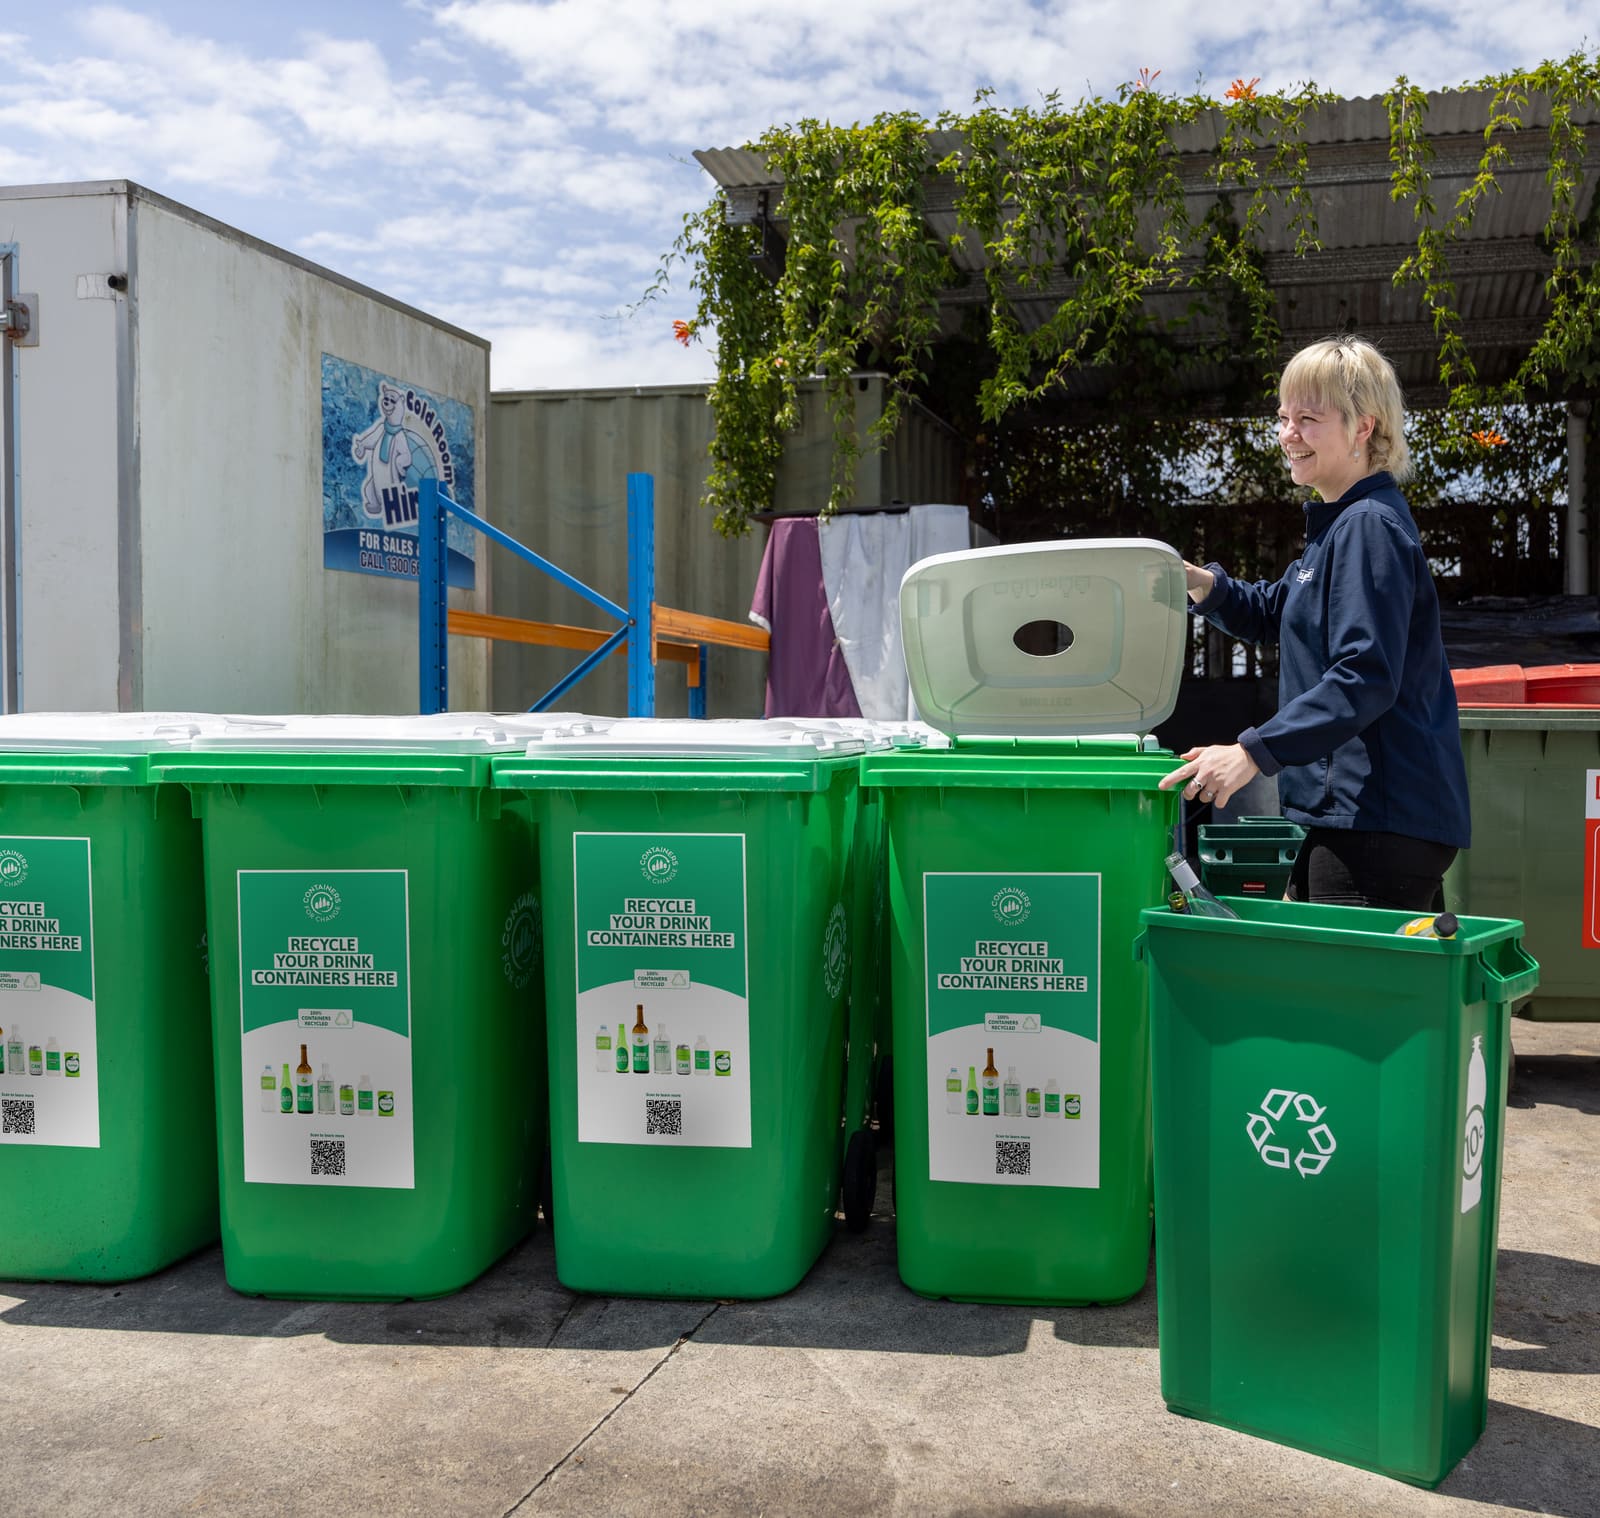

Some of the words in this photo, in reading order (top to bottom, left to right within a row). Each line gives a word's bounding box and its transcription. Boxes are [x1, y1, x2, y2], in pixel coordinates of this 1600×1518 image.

[406, 390, 434, 427] Cold
[432, 422, 454, 486] Room
[360, 531, 380, 550] FOR
[383, 536, 413, 556] SALES
[360, 550, 384, 570] CALL
[386, 555, 409, 575] 1300
[640, 846, 679, 866] CONTAINERS
[4, 872, 28, 887] CHANGE
[641, 868, 652, 881] FOR
[652, 868, 678, 884] CHANGE
[303, 884, 342, 904] CONTAINERS
[992, 888, 1032, 908] CONTAINERS
[304, 905, 316, 919] FOR
[316, 906, 341, 922] CHANGE
[628, 900, 692, 913] RECYCLE
[612, 916, 656, 929] YOUR
[660, 916, 708, 930] DRINK
[992, 908, 1004, 922] FOR
[1004, 910, 1031, 926] CHANGE
[12, 920, 58, 932] DRINK
[42, 936, 79, 950] HERE
[291, 938, 356, 952] RECYCLE
[590, 932, 686, 946] CONTAINERS
[692, 934, 732, 946] HERE
[978, 942, 1045, 956] RECYCLE
[276, 954, 318, 968] YOUR
[324, 956, 371, 968] DRINK
[963, 959, 1006, 972] YOUR
[1012, 960, 1061, 973] DRINK
[254, 972, 350, 985] CONTAINERS
[354, 972, 394, 986] HERE
[940, 976, 1038, 990] CONTAINERS
[1044, 977, 1084, 990] HERE
